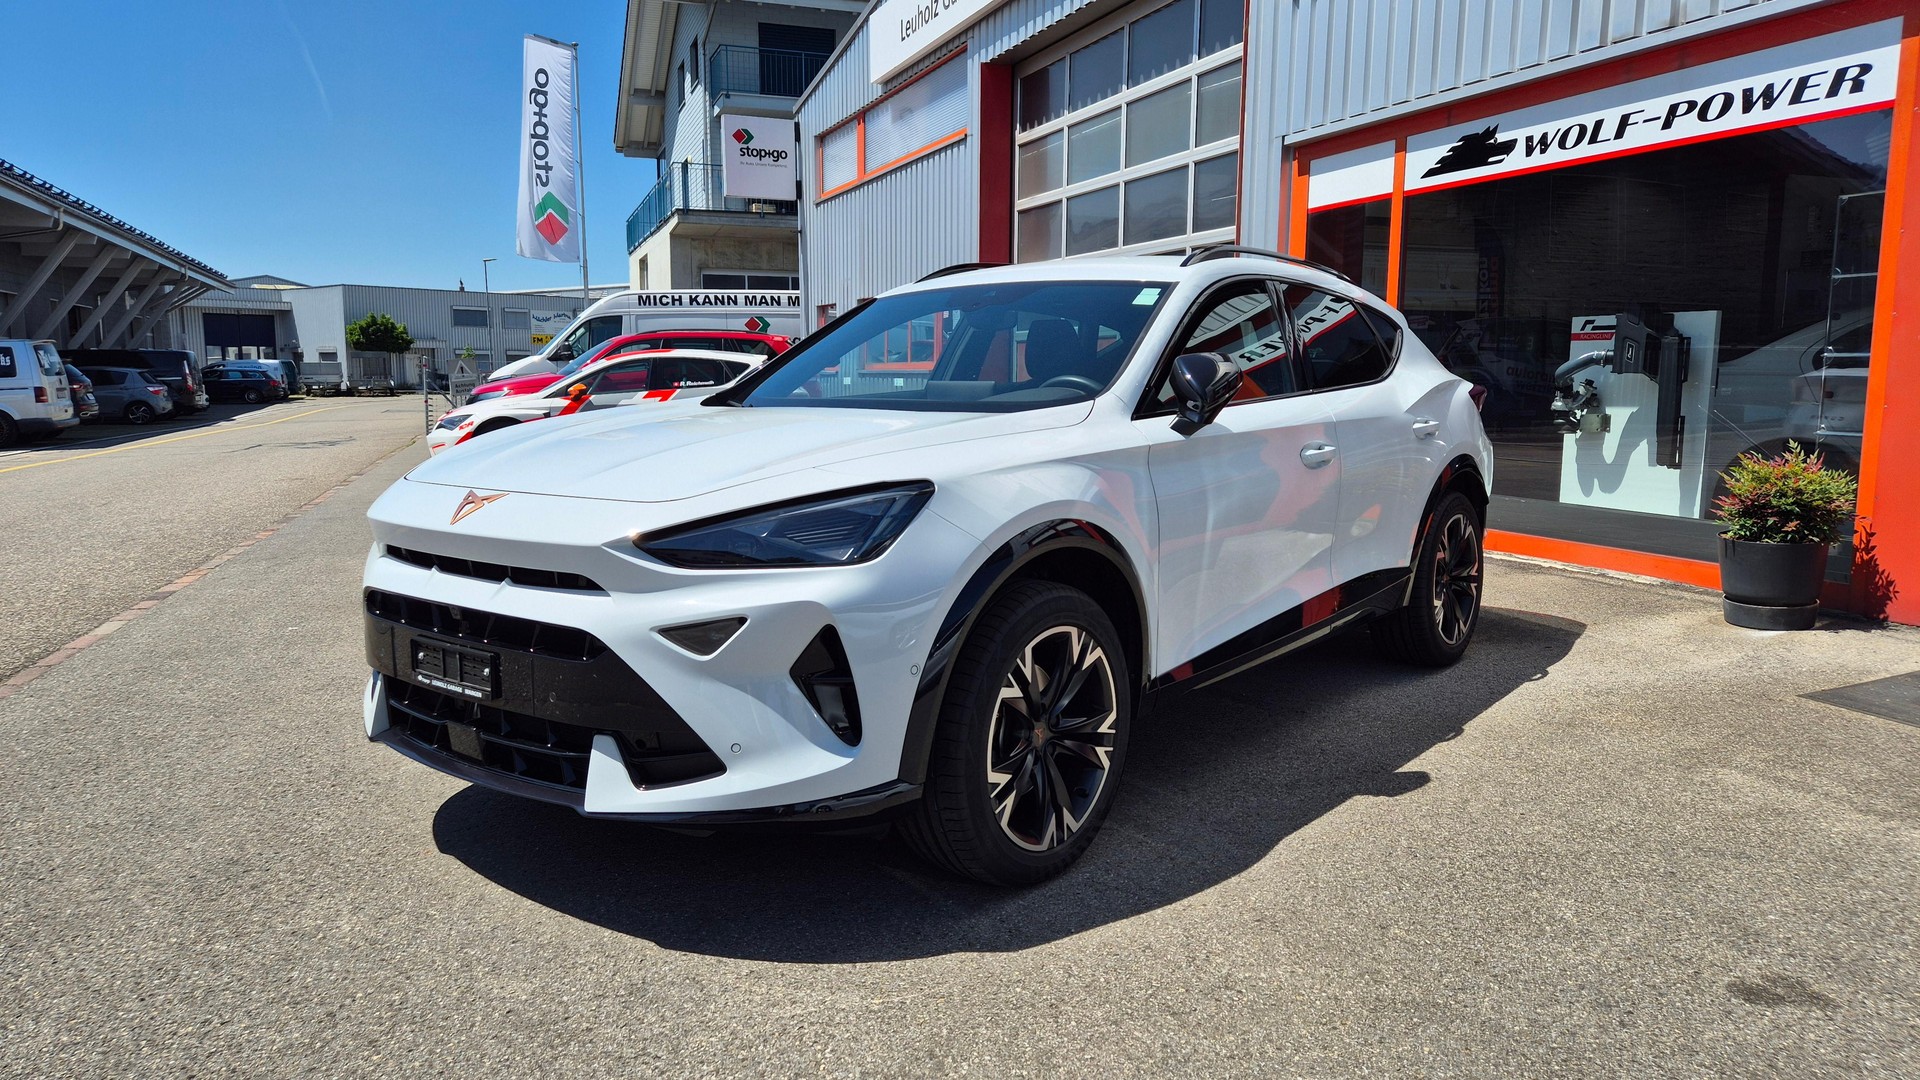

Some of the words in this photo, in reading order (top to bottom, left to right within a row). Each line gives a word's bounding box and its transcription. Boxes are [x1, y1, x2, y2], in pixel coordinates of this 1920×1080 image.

[900, 0, 939, 42] Leuholz
[1524, 62, 1874, 159] WOLF-POWER
[740, 146, 788, 162] stop+go
[638, 295, 682, 306] MICH
[689, 295, 738, 306] KANN
[744, 295, 781, 307] MAN
